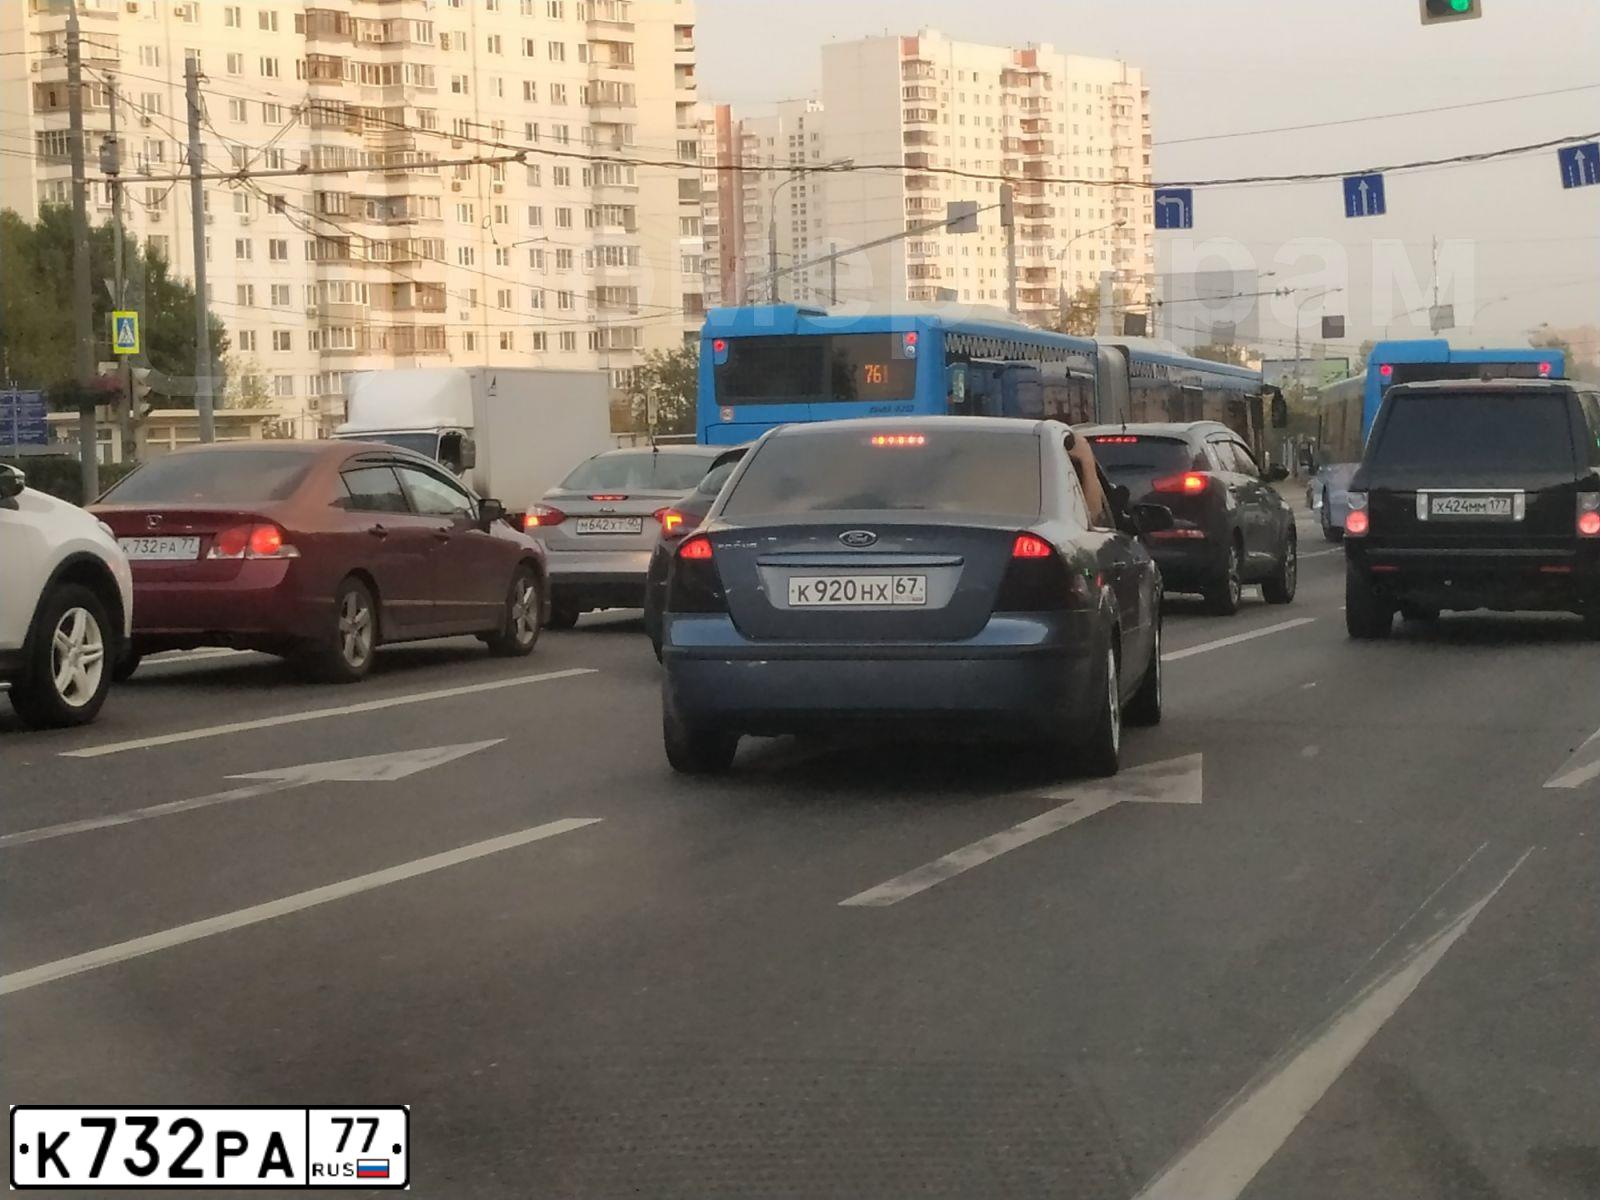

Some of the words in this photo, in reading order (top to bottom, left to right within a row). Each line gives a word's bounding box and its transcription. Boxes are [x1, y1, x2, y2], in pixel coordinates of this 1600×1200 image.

[182, 538, 195, 550] 77
[797, 579, 888, 602] К920НХ
[895, 577, 918, 594] 67
